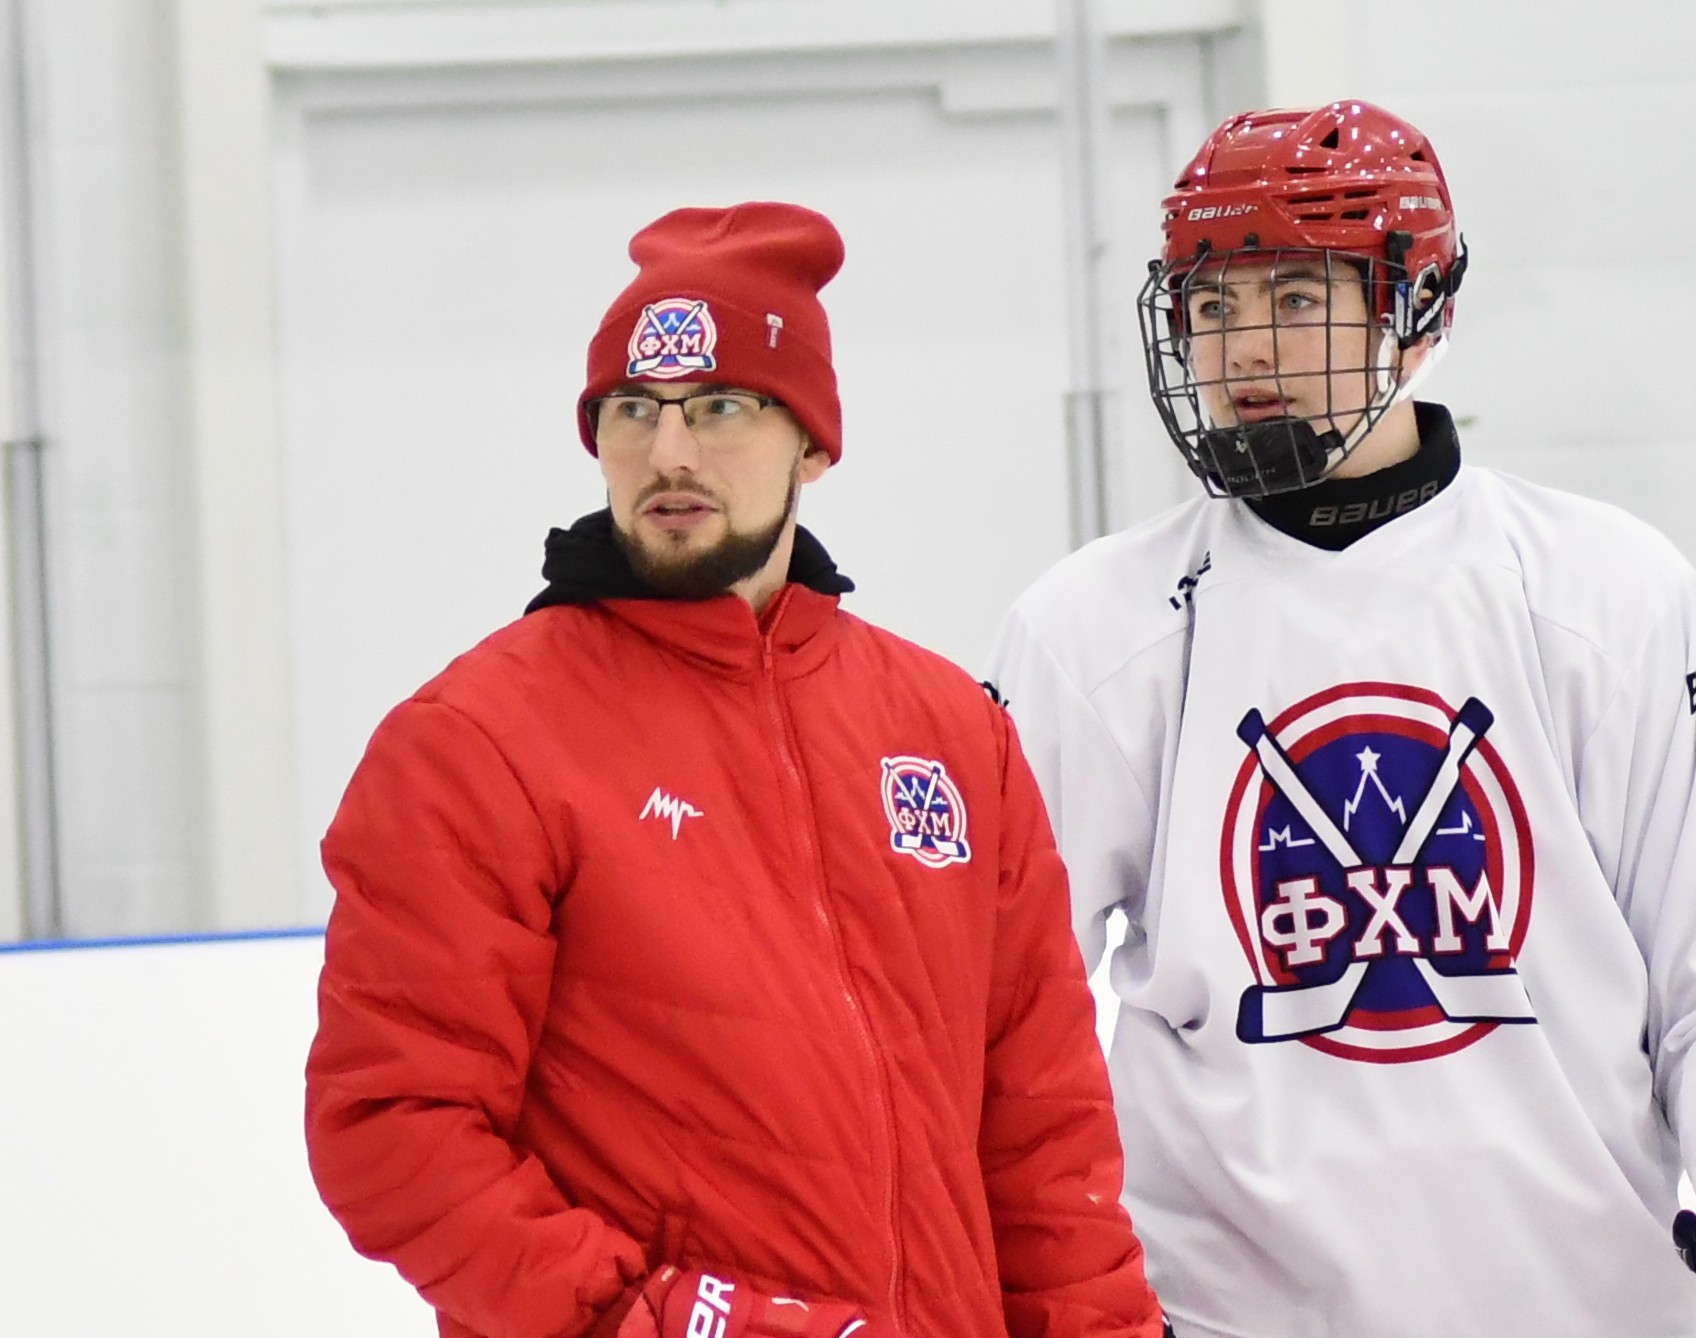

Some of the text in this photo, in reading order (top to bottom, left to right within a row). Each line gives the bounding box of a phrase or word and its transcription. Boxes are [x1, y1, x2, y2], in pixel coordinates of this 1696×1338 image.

[639, 333, 702, 358] ФХМ
[1309, 480, 1439, 526] BAUER
[898, 807, 952, 836] ФХМ
[1260, 867, 1510, 967] ФХМ
